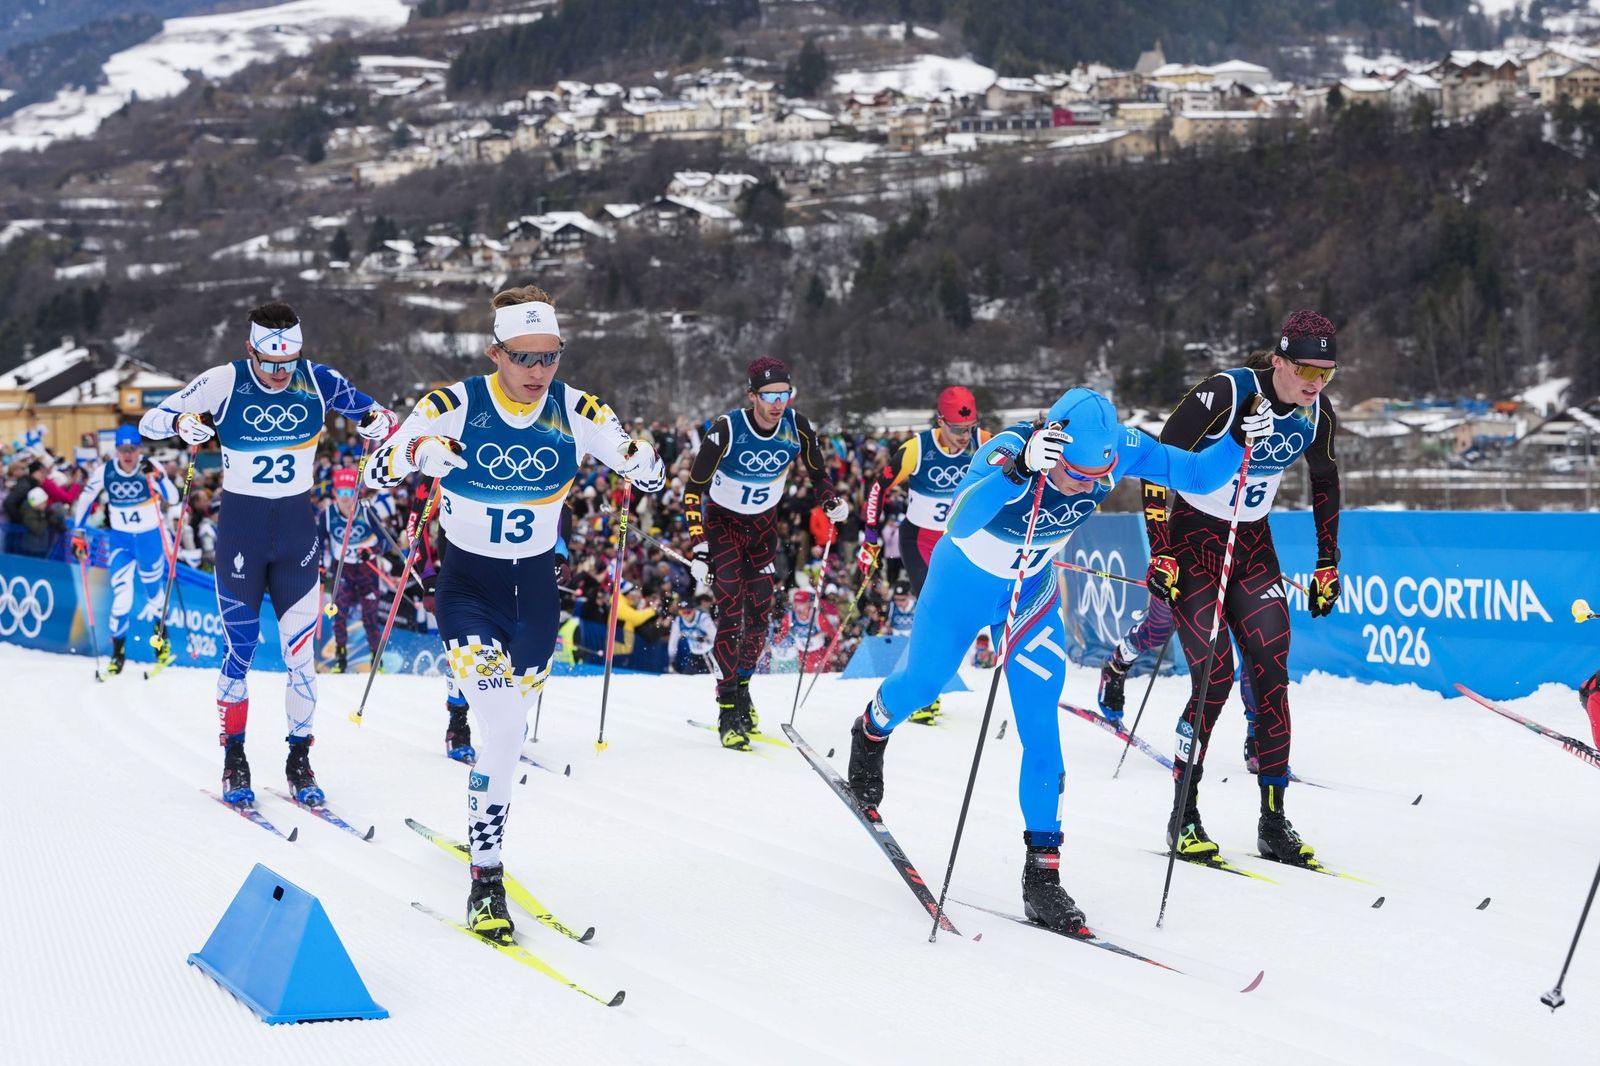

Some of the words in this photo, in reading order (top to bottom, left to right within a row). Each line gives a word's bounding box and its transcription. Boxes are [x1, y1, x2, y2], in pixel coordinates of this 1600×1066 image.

[180, 380, 202, 399] CRAFT
[1126, 427, 1138, 447] EA
[223, 453, 230, 469] 3
[252, 453, 296, 484] 23
[468, 480, 504, 491] MILANO
[544, 483, 560, 491] 2026
[741, 485, 770, 505] 15
[1229, 478, 1268, 508] 16
[442, 495, 452, 515] 3
[866, 482, 880, 526] CANADA
[933, 502, 950, 522] 3
[1145, 484, 1166, 522] ER
[119, 511, 142, 525] 14
[486, 506, 535, 544] 13
[684, 493, 704, 536] GER
[1003, 527, 1038, 537] MILAO
[1039, 528, 1072, 537] CORTINA
[300, 540, 319, 568] CRAFT
[1010, 547, 1051, 570] 11
[1281, 572, 1388, 616] MINO
[1394, 577, 1553, 623] CORTINA
[1014, 625, 1066, 681] IT
[1362, 623, 1431, 668] 2026
[477, 677, 514, 691] SWE
[1179, 738, 1192, 755] 16
